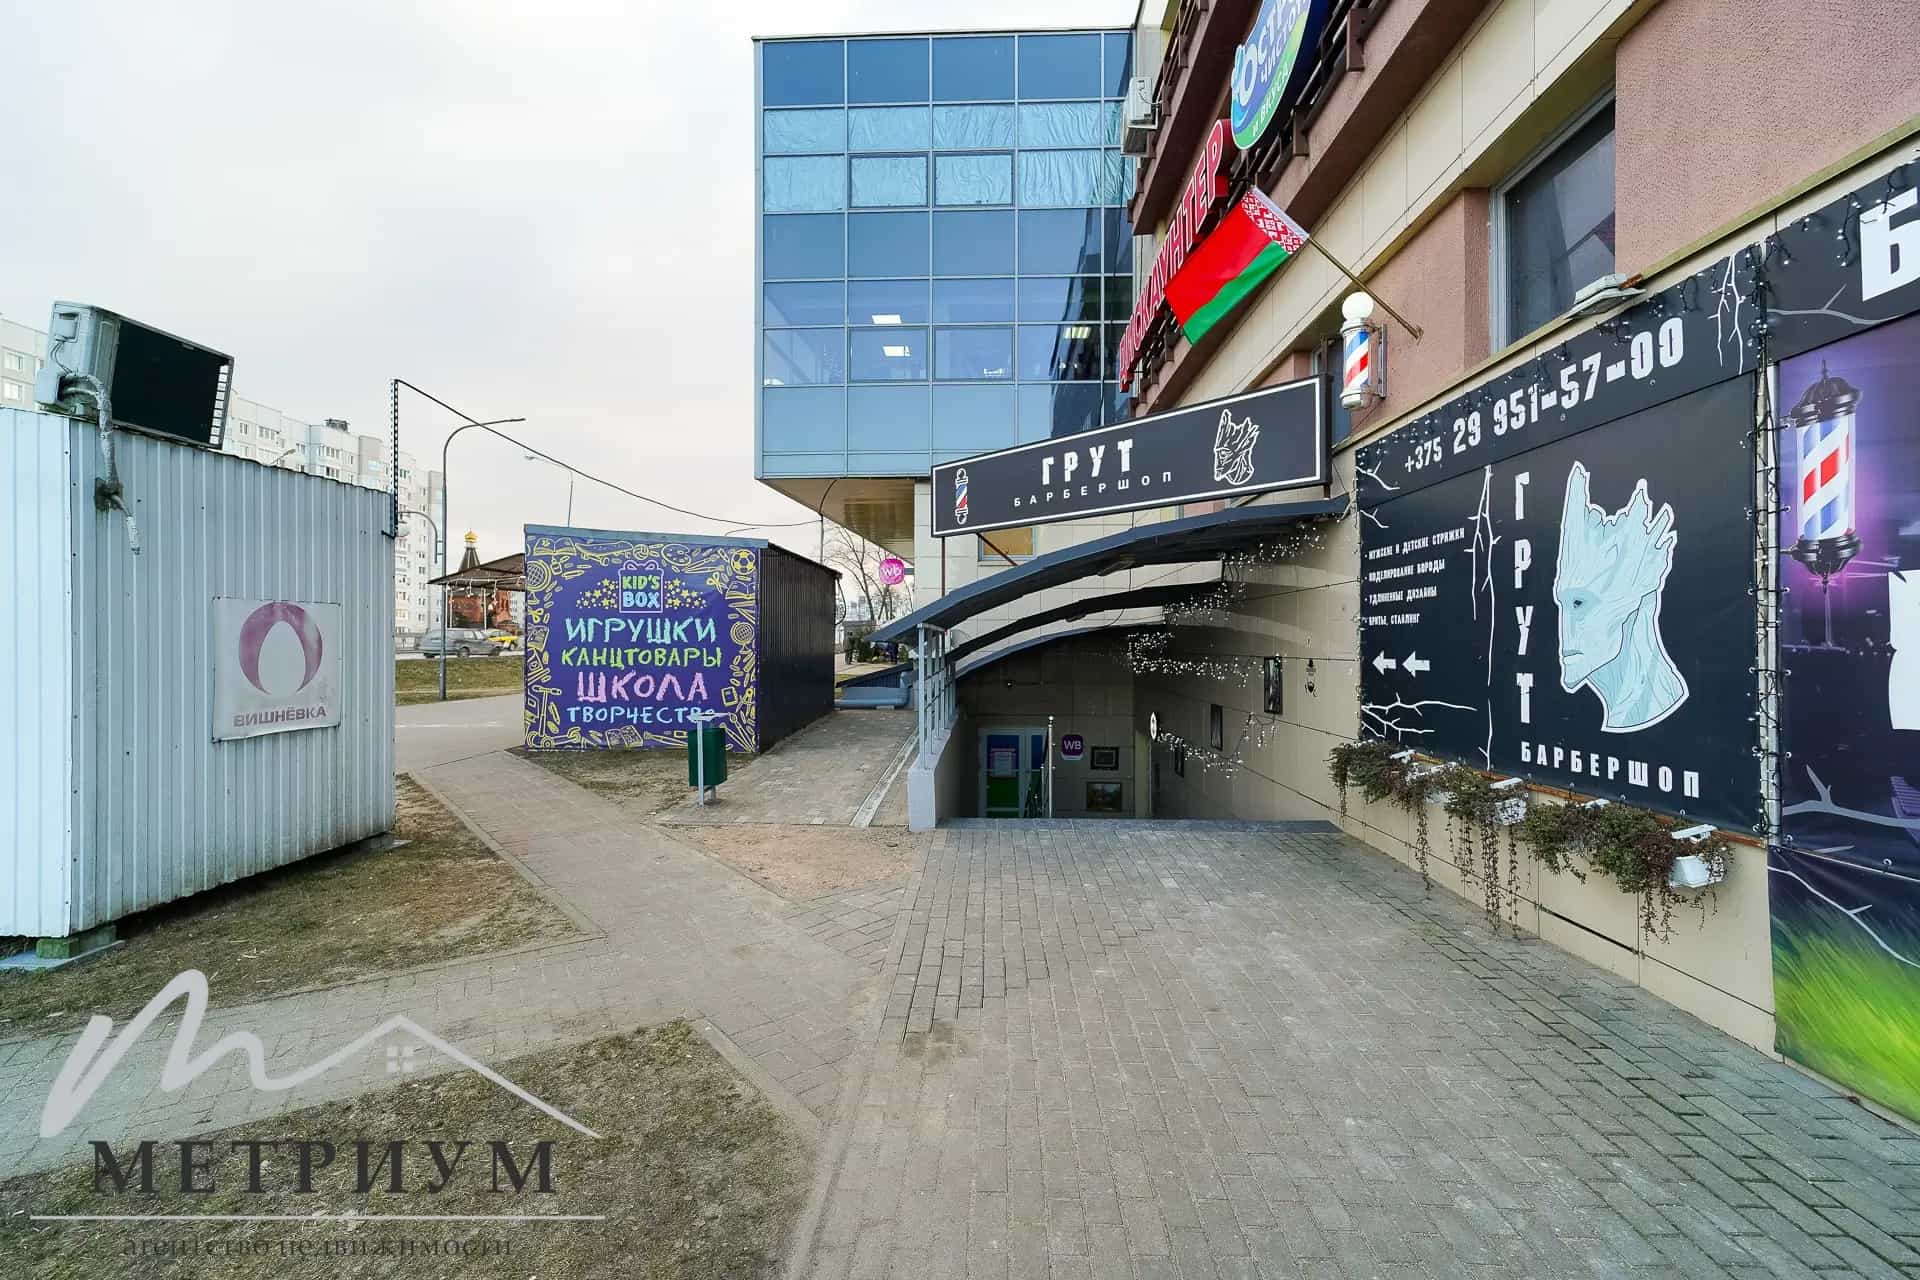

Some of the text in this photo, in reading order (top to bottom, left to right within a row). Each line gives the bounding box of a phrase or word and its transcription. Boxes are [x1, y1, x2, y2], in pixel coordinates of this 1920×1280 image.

[1404, 317, 1684, 473] +375 29 951-57-00
[1042, 438, 1133, 485] ГРУТ
[1014, 471, 1172, 507] БАРБЕРШОП
[1432, 527, 1465, 545] СТРИЖКИ
[622, 574, 661, 591] KID'S
[622, 591, 661, 608] BOX
[565, 615, 716, 644] ИГРУШКИ
[561, 647, 722, 670] КАНЦТОВАРЫ
[577, 671, 709, 702] ШКОЛА
[233, 705, 327, 727] ВИШНЁВКА
[1063, 740, 1082, 750] WB
[1521, 741, 1701, 799] БАРБЕРШОП
